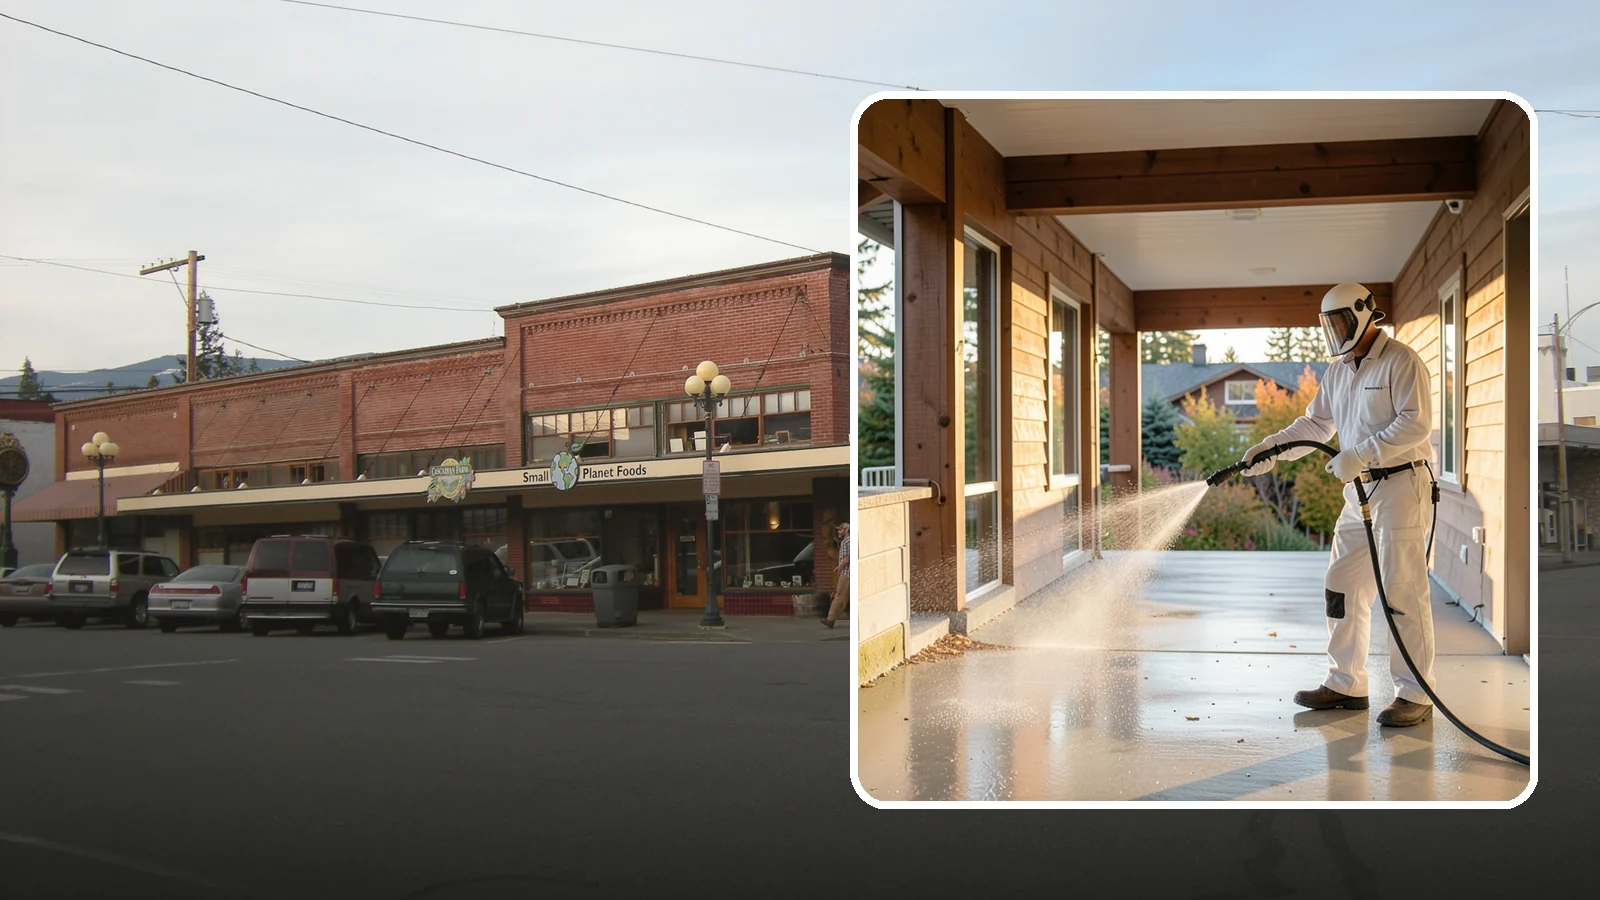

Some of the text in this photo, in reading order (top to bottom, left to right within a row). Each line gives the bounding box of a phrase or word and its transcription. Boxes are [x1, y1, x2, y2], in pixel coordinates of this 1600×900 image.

[523, 464, 647, 483] Small Planet Foods
